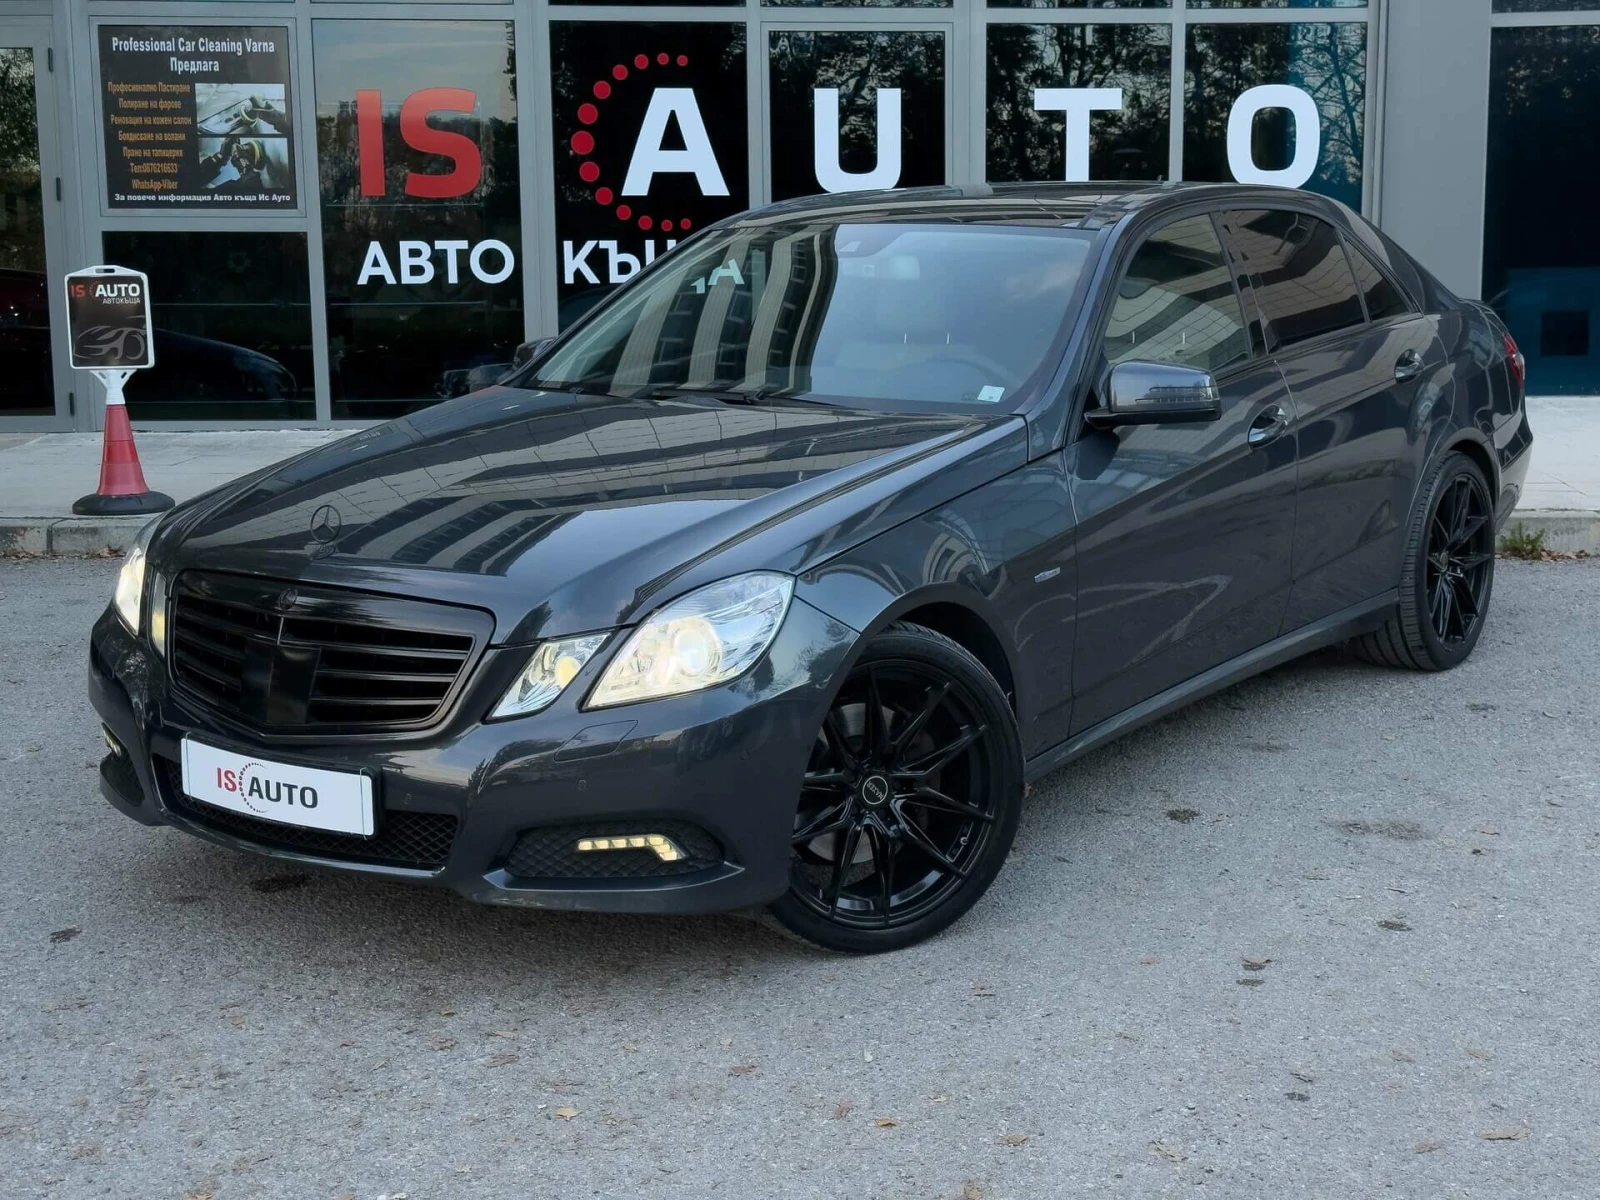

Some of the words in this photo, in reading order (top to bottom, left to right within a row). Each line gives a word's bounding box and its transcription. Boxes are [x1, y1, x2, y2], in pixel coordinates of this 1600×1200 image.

[112, 37, 175, 52] Professional
[178, 38, 196, 51] Car
[198, 38, 243, 56] Cleaning
[244, 39, 275, 53] Varna
[170, 57, 219, 75] Предлага
[107, 81, 158, 95] Професионално
[119, 98, 149, 111] Полиране
[149, 101, 158, 109] на
[158, 98, 182, 111] фарове
[110, 114, 143, 126] Реновация
[143, 116, 152, 125] на
[173, 116, 192, 125] салон
[154, 133, 163, 141] на
[357, 87, 482, 198] IS
[621, 85, 1321, 197] AUTO
[123, 146, 143, 159] Пране
[143, 149, 152, 157] на
[115, 193, 126, 201] За
[158, 193, 212, 203] информация
[213, 193, 233, 201] Авто
[234, 195, 257, 203] къща
[258, 193, 270, 201] Ис
[271, 193, 291, 203] Ауто
[357, 238, 515, 285] АВТО
[71, 284, 86, 298] IS
[95, 283, 141, 297] AUTO
[217, 767, 237, 792] IS
[248, 776, 318, 809] AUTO
